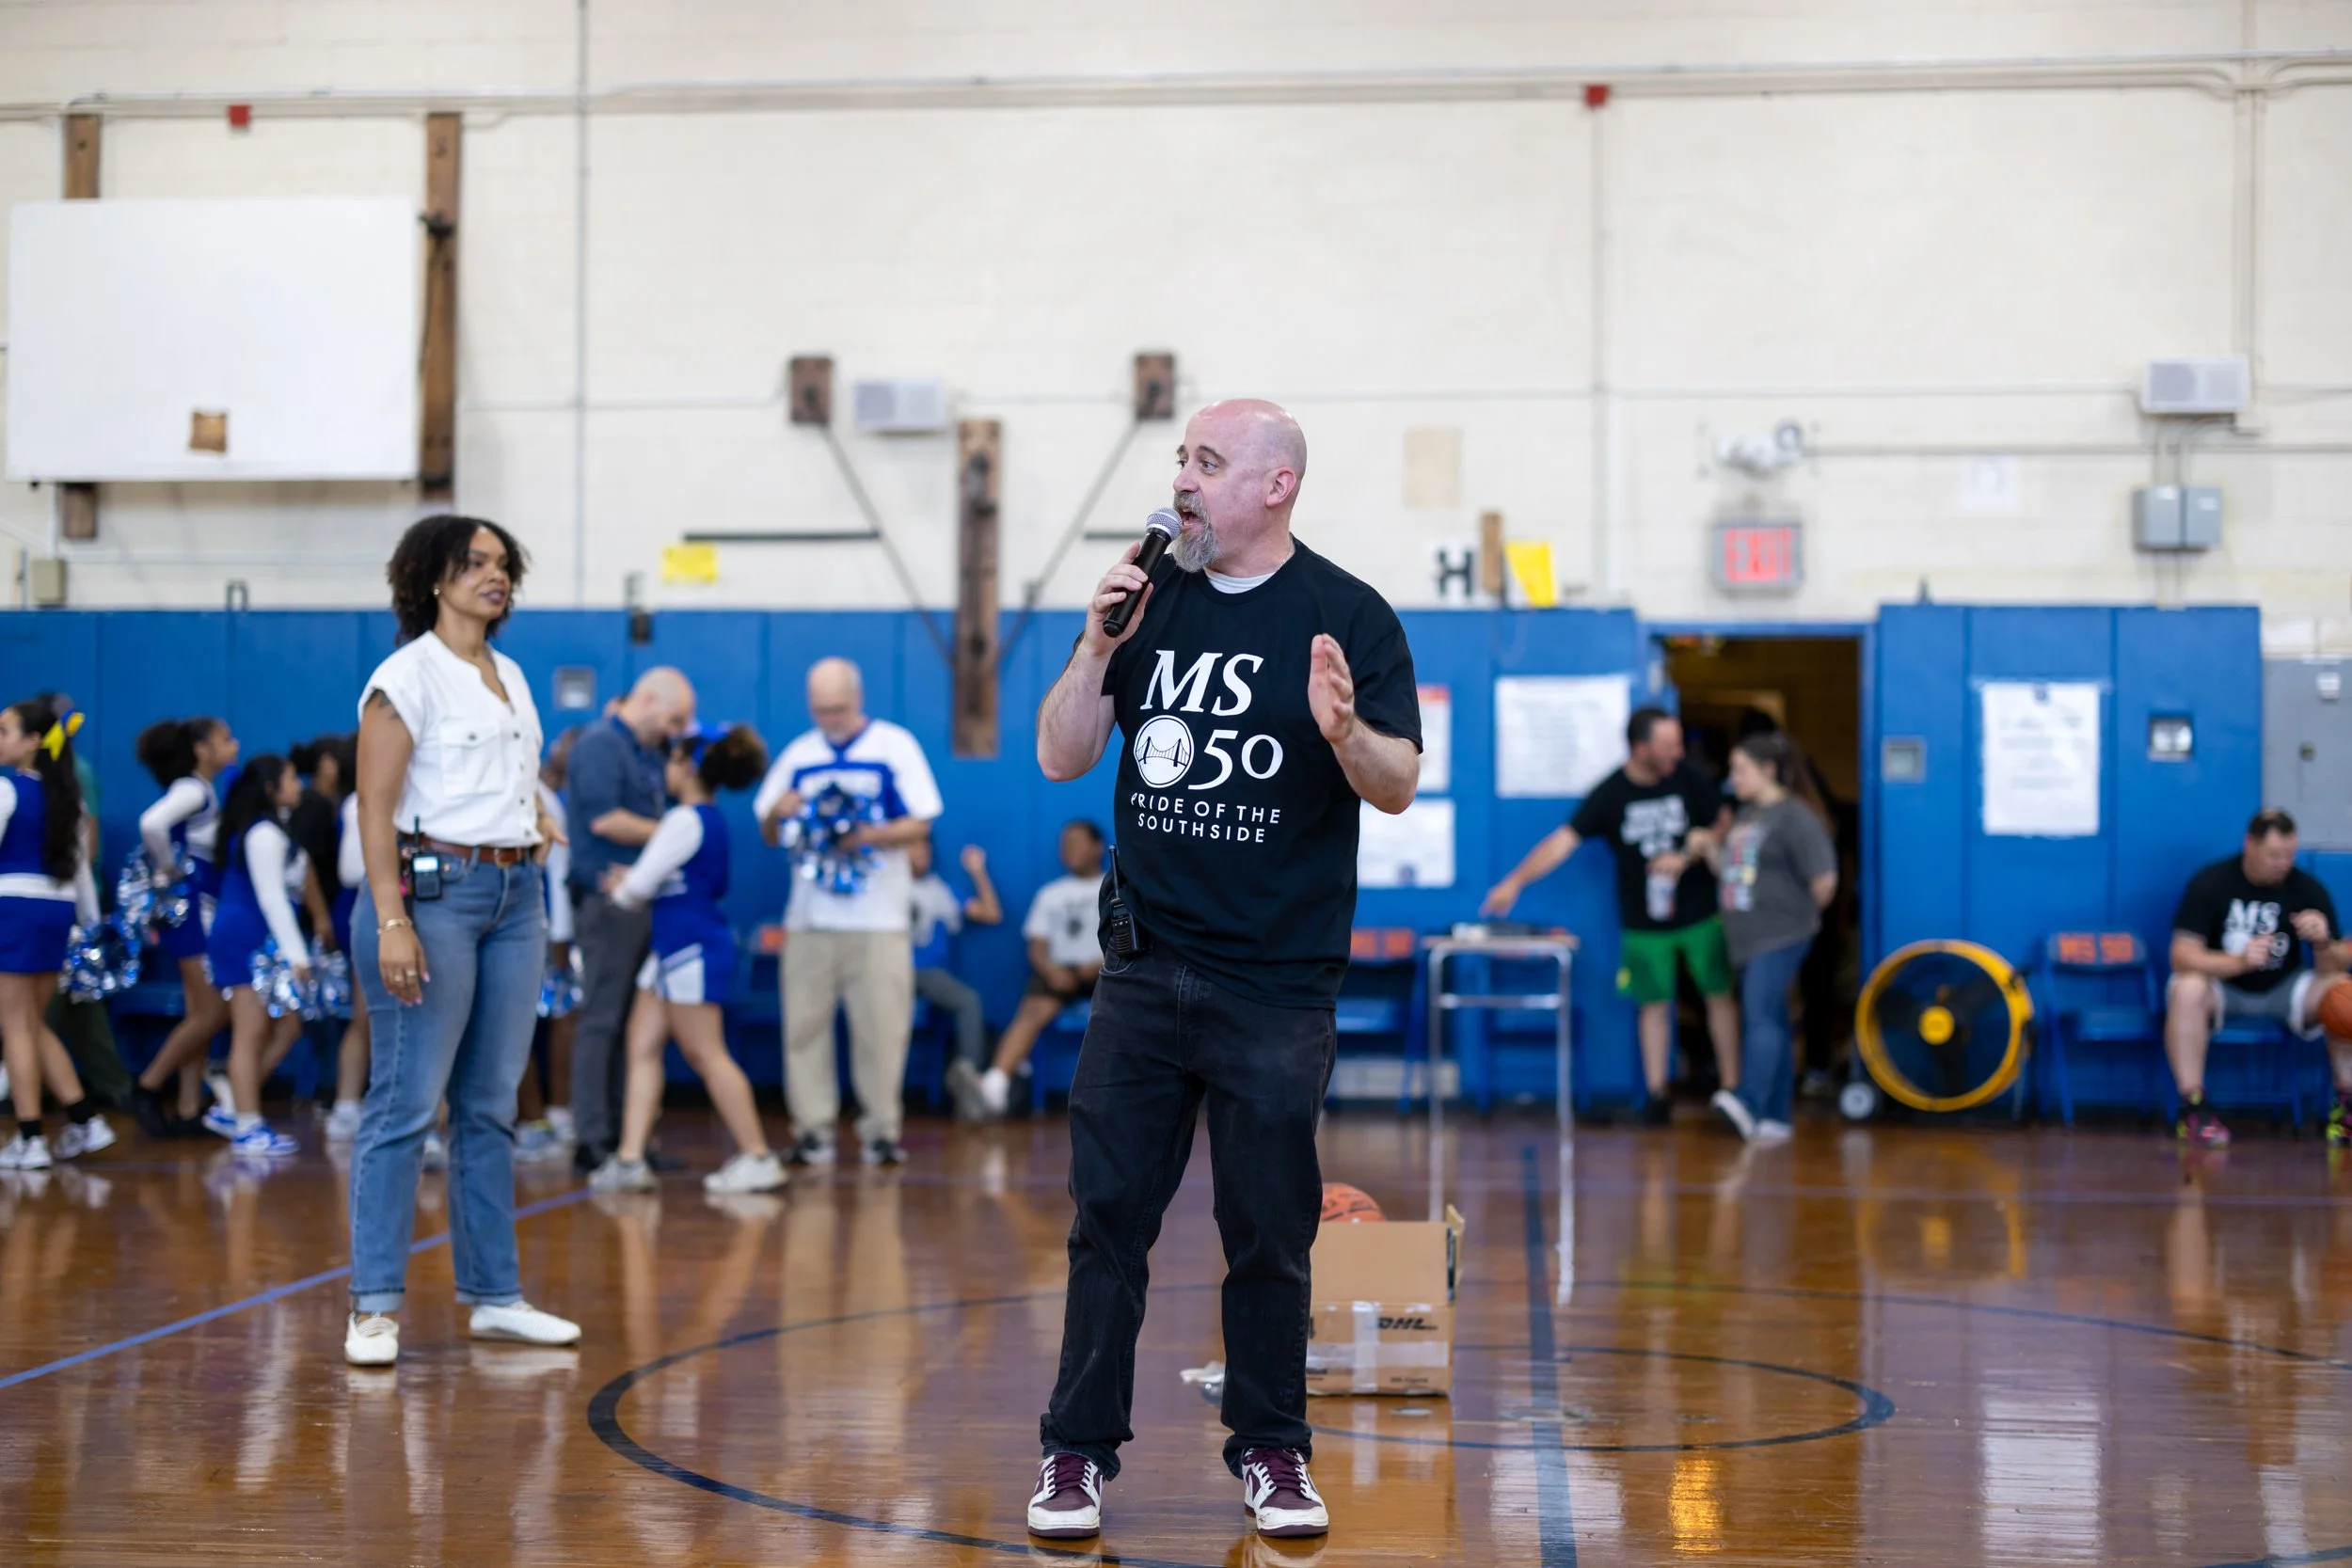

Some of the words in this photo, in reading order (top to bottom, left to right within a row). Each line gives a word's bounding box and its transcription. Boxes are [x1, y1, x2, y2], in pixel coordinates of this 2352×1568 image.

[1724, 527, 1793, 583] EXIT
[1139, 649, 1264, 717] MS
[1187, 729, 1284, 790] 50
[1130, 792, 1184, 815] PRIDE
[1194, 800, 1226, 818] OF
[1236, 805, 1280, 824] THE
[1137, 813, 1265, 843] SOUTHSIDE
[2224, 897, 2281, 935] MS
[1376, 1316, 1438, 1331] DHL
